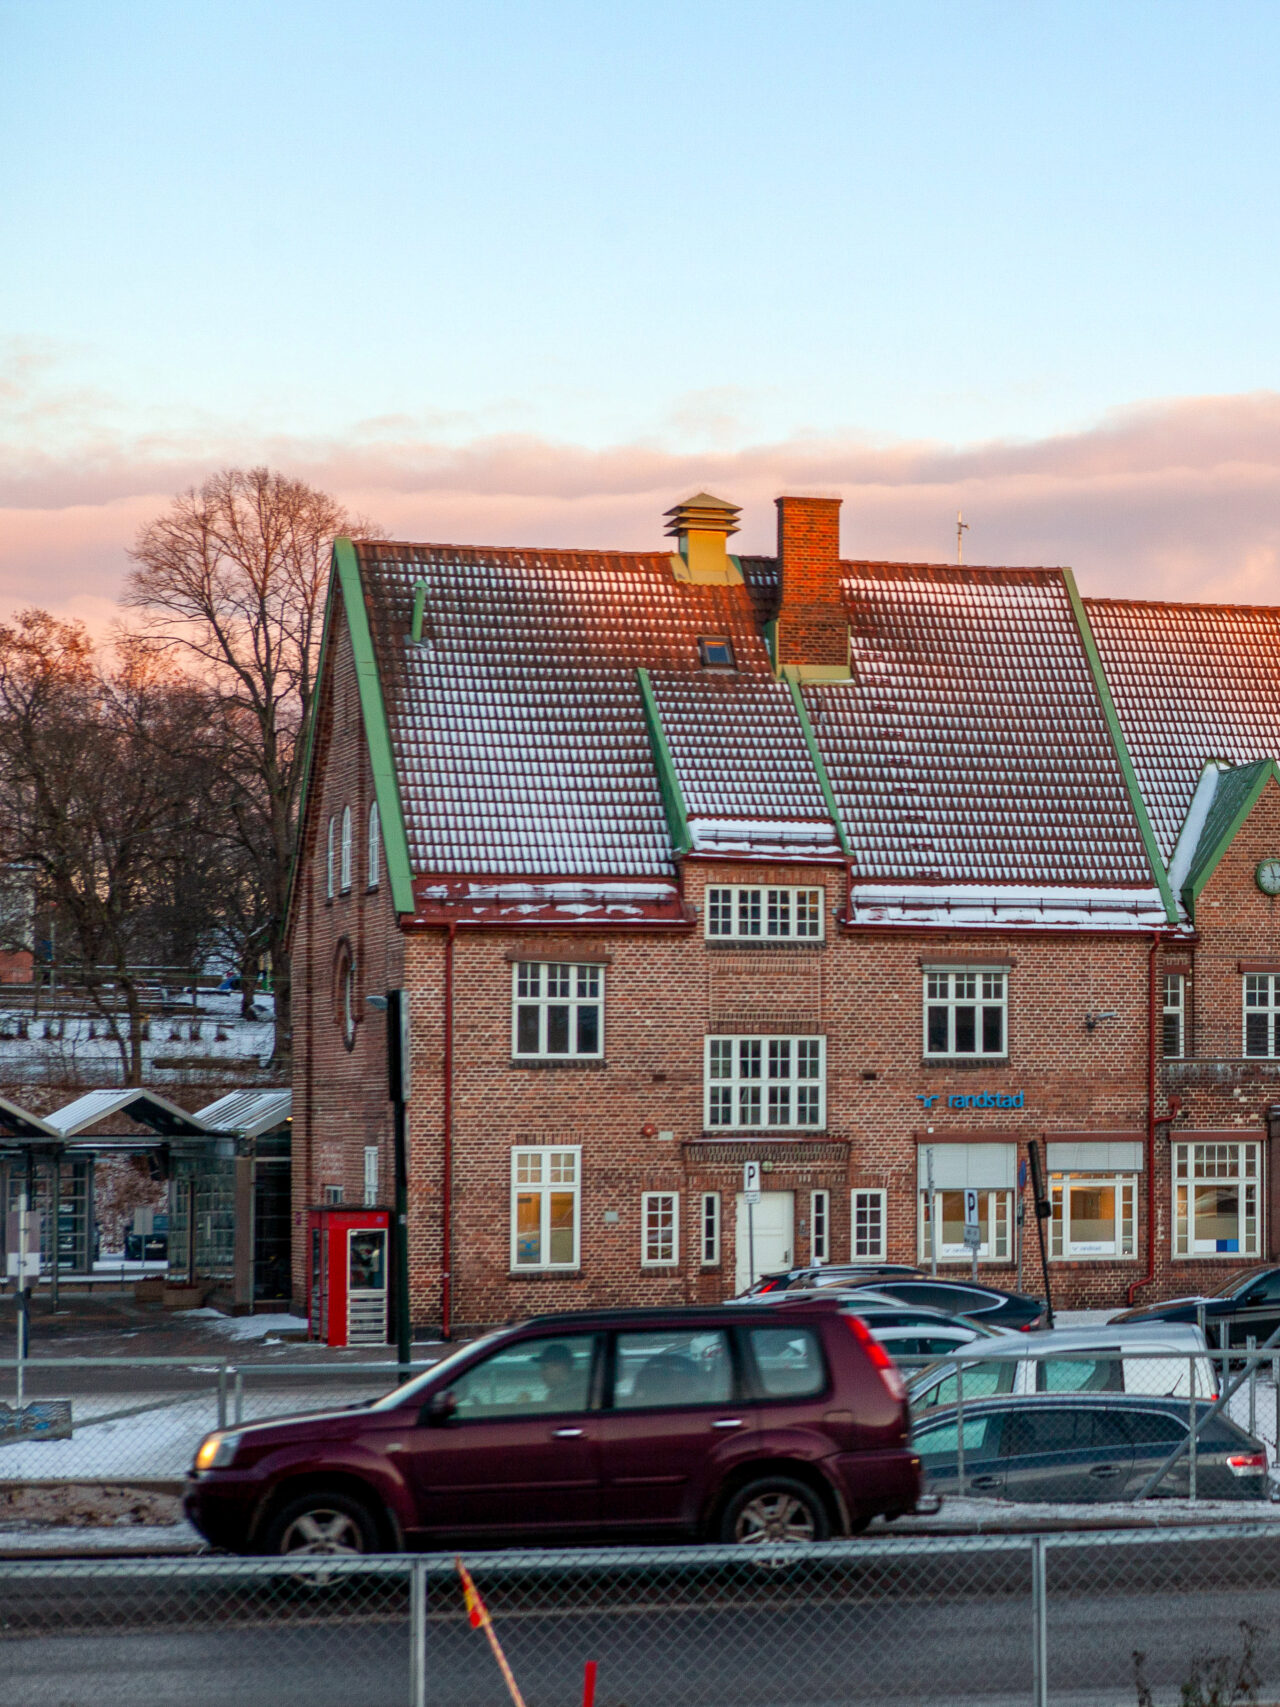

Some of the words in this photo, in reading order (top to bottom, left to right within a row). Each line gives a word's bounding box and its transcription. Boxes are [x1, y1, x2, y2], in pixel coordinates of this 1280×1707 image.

[947, 1088, 1025, 1108] randstad
[747, 1165, 756, 1188] P
[967, 1192, 976, 1223] P
